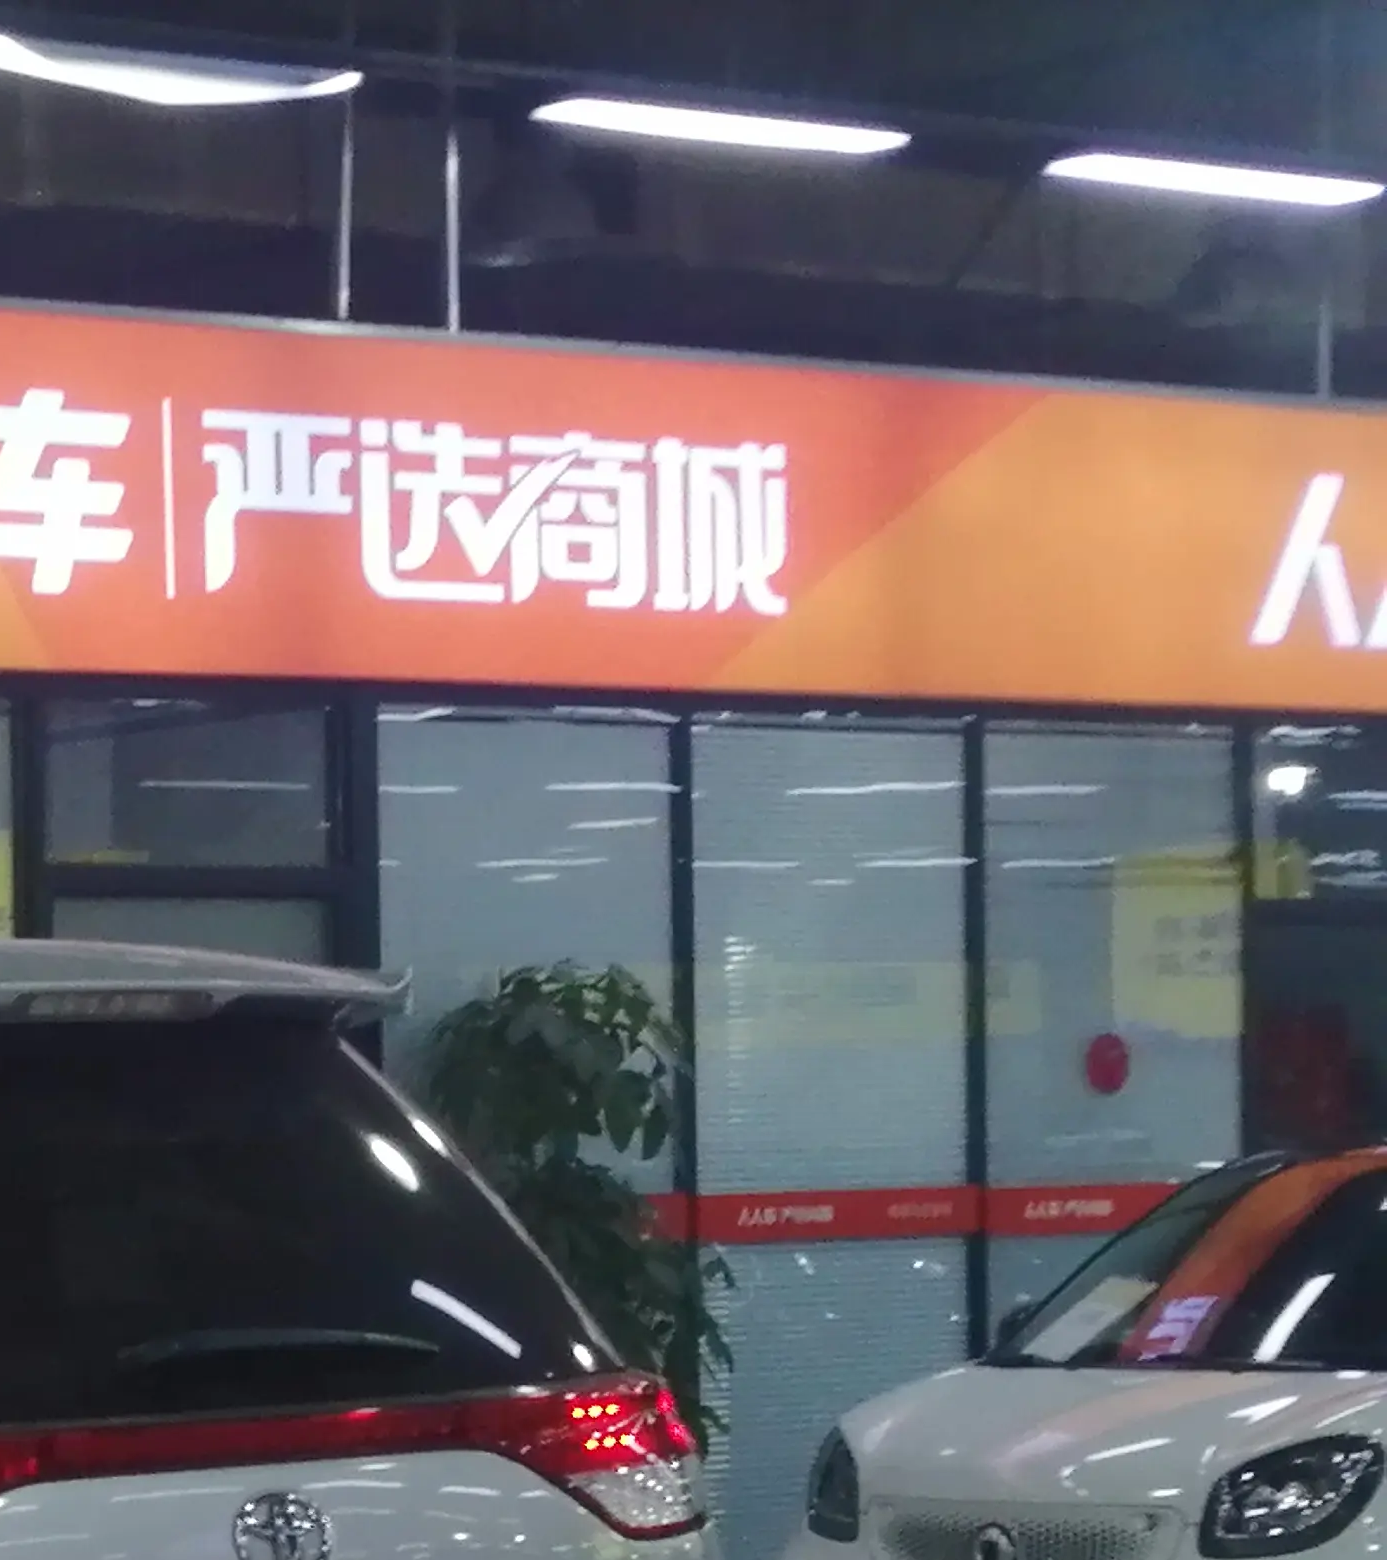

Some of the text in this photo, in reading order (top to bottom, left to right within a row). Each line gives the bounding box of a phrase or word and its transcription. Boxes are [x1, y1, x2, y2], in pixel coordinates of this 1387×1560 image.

[200, 408, 790, 617] 严选商城
[1248, 472, 1387, 649] 人
